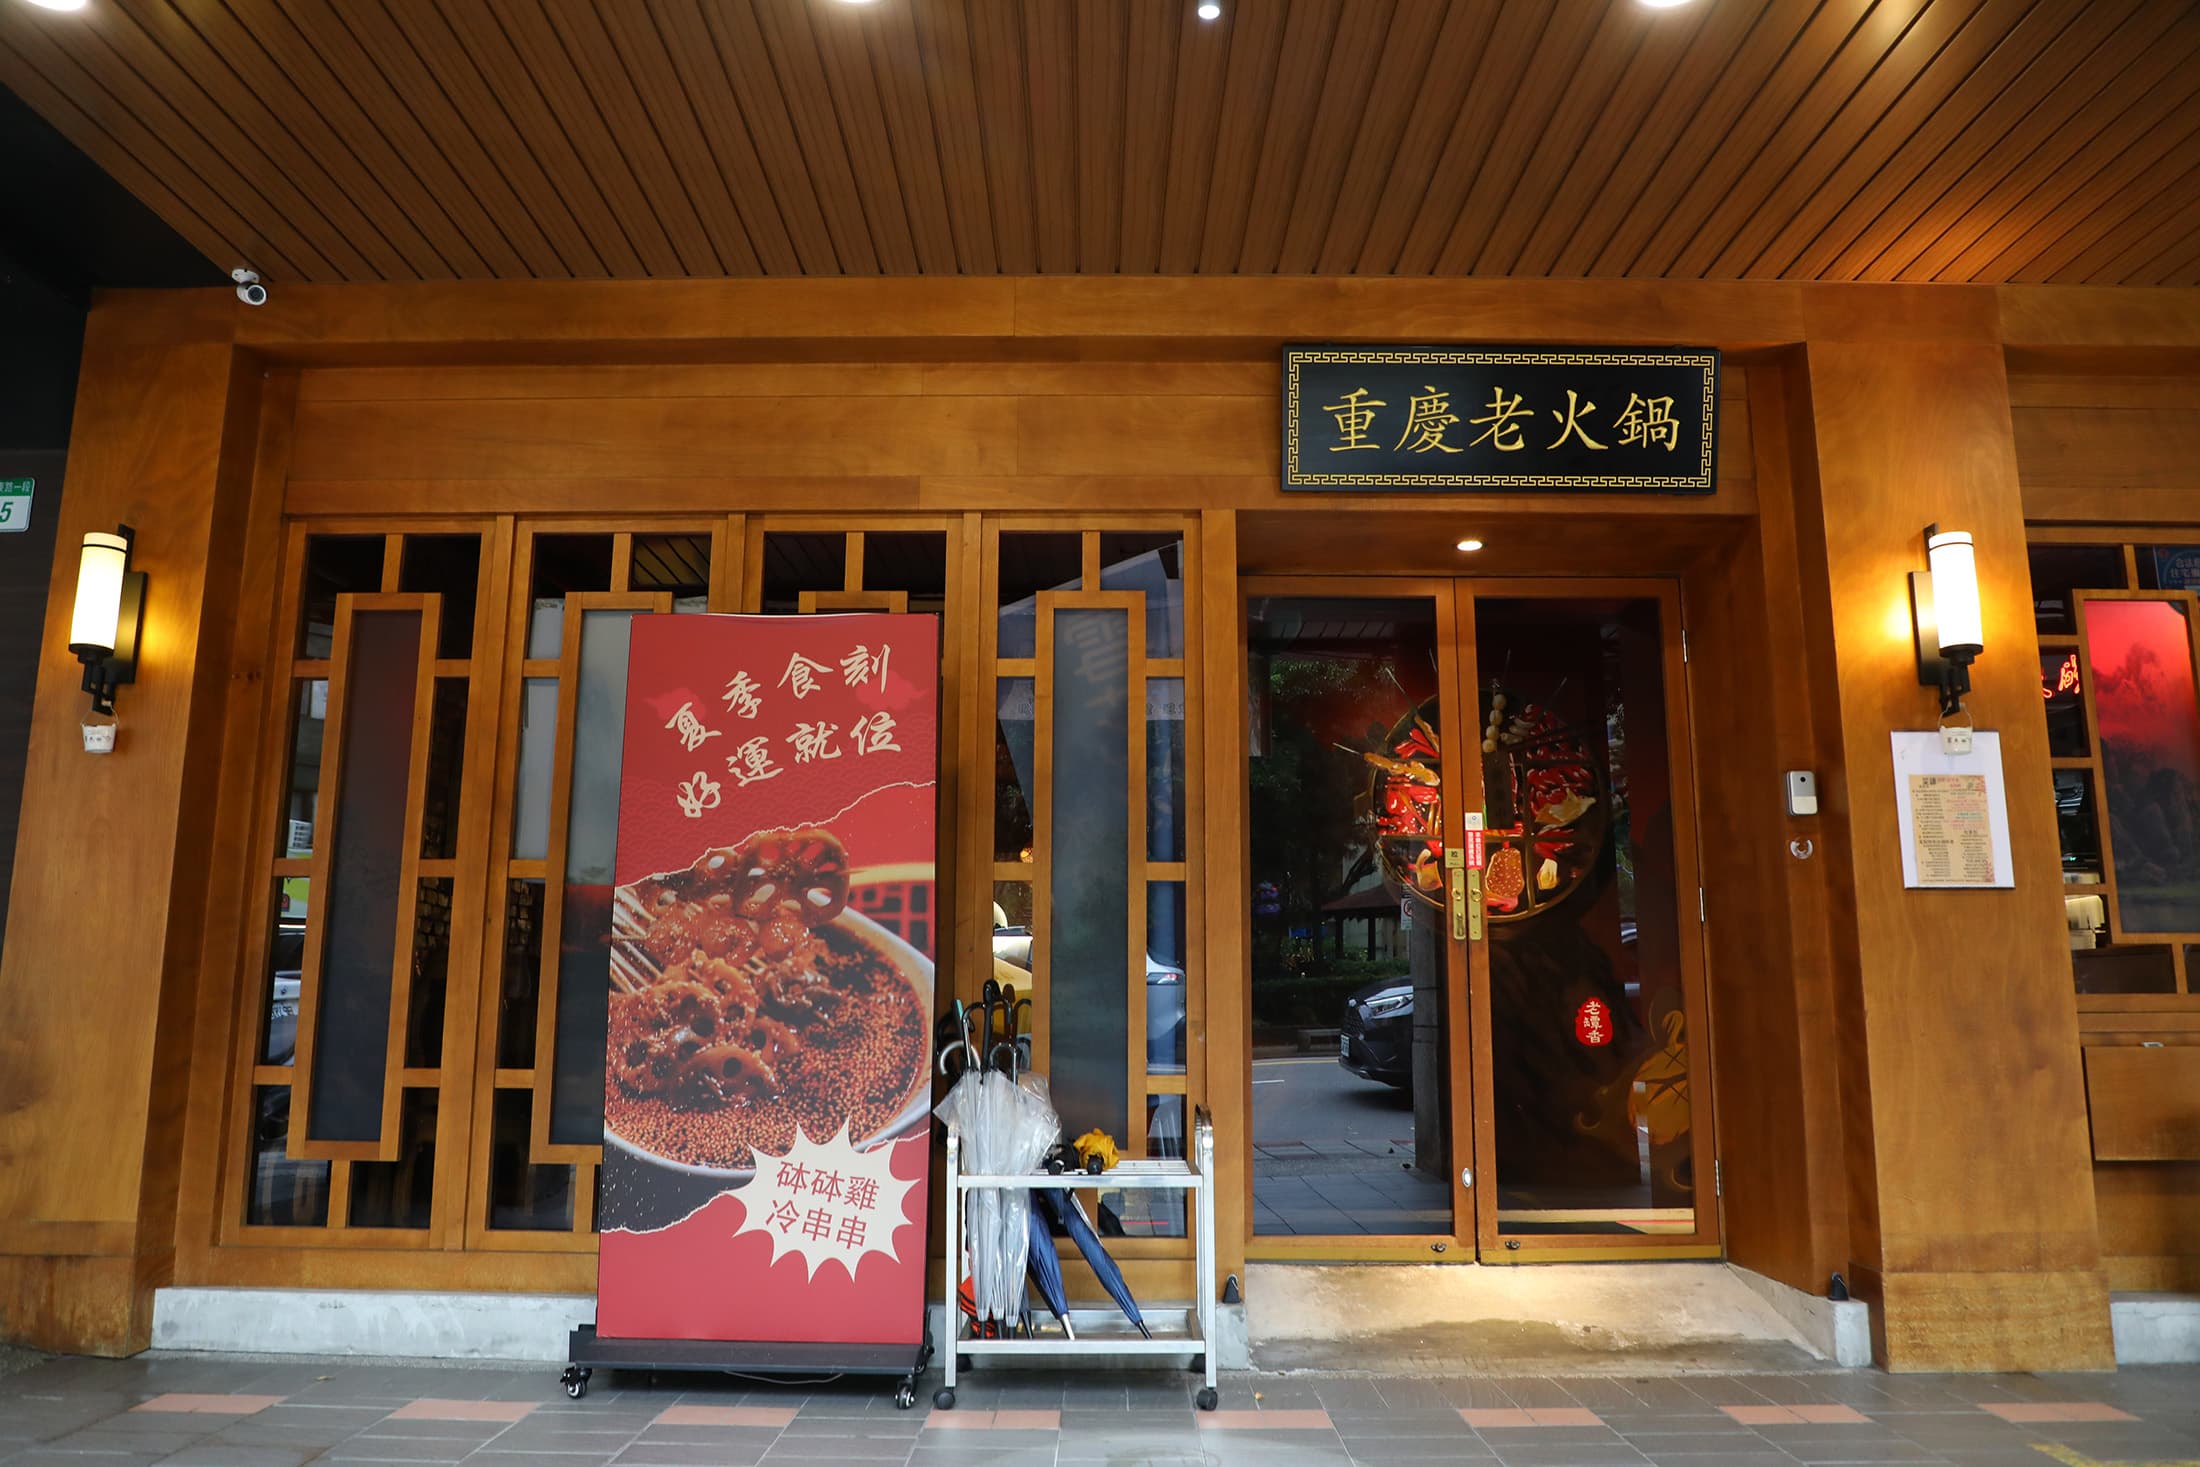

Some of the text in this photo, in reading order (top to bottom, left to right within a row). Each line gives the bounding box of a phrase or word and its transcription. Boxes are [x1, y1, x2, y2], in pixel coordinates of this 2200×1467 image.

[1323, 385, 1680, 453] 重慶老火鍋
[0, 501, 13, 523] 5
[664, 643, 891, 752] 夏季食刻
[676, 711, 902, 818] 好運就位
[776, 1160, 881, 1211] 砵砵雞
[765, 1199, 868, 1250] 冷串串
